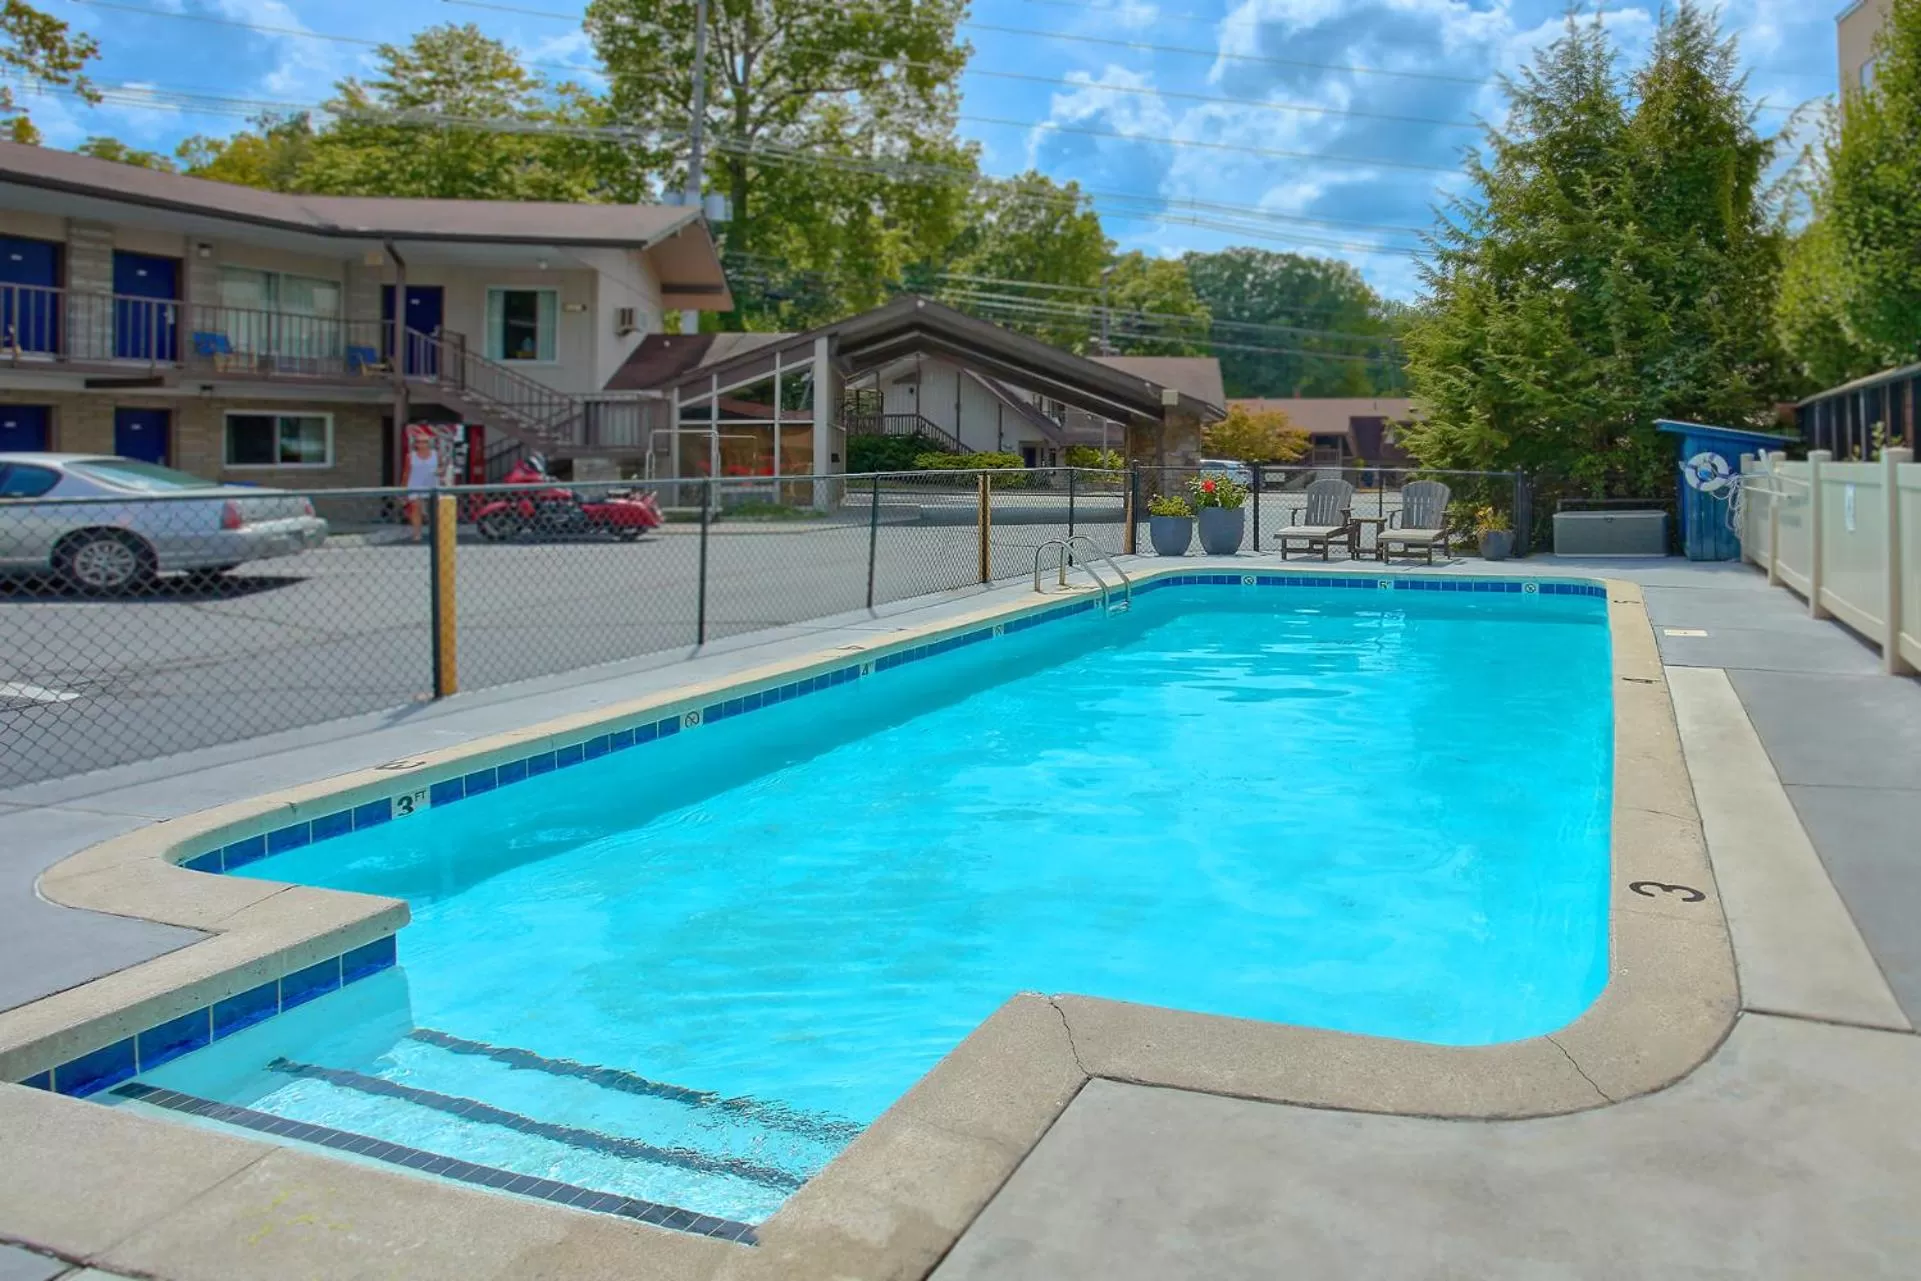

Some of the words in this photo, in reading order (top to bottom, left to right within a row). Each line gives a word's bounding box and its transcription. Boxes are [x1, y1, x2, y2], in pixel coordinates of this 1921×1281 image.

[397, 795, 414, 817] 3
[414, 789, 426, 801] FT
[1629, 881, 1706, 903] 3
